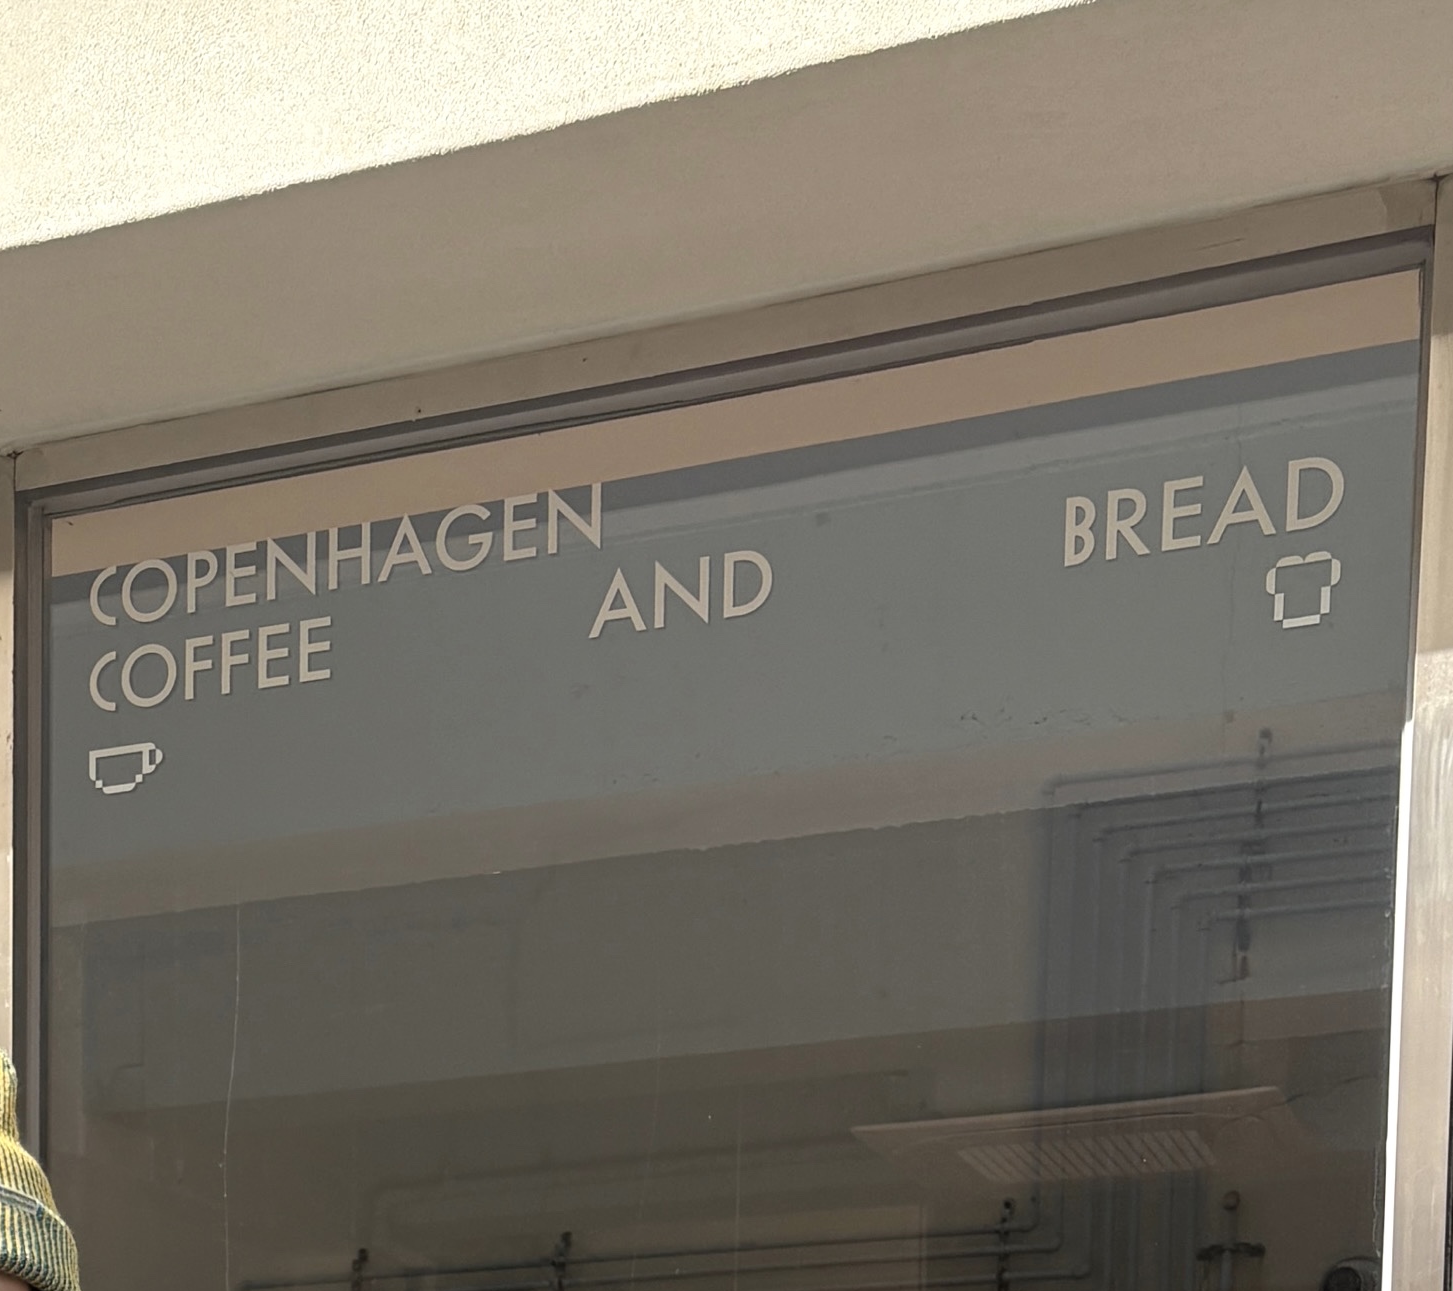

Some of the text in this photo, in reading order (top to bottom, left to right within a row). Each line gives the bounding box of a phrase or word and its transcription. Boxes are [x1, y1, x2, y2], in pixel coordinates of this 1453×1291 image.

[89, 481, 603, 626] COPENHAGEN
[89, 456, 1345, 711] COFFEE AND BREAD
